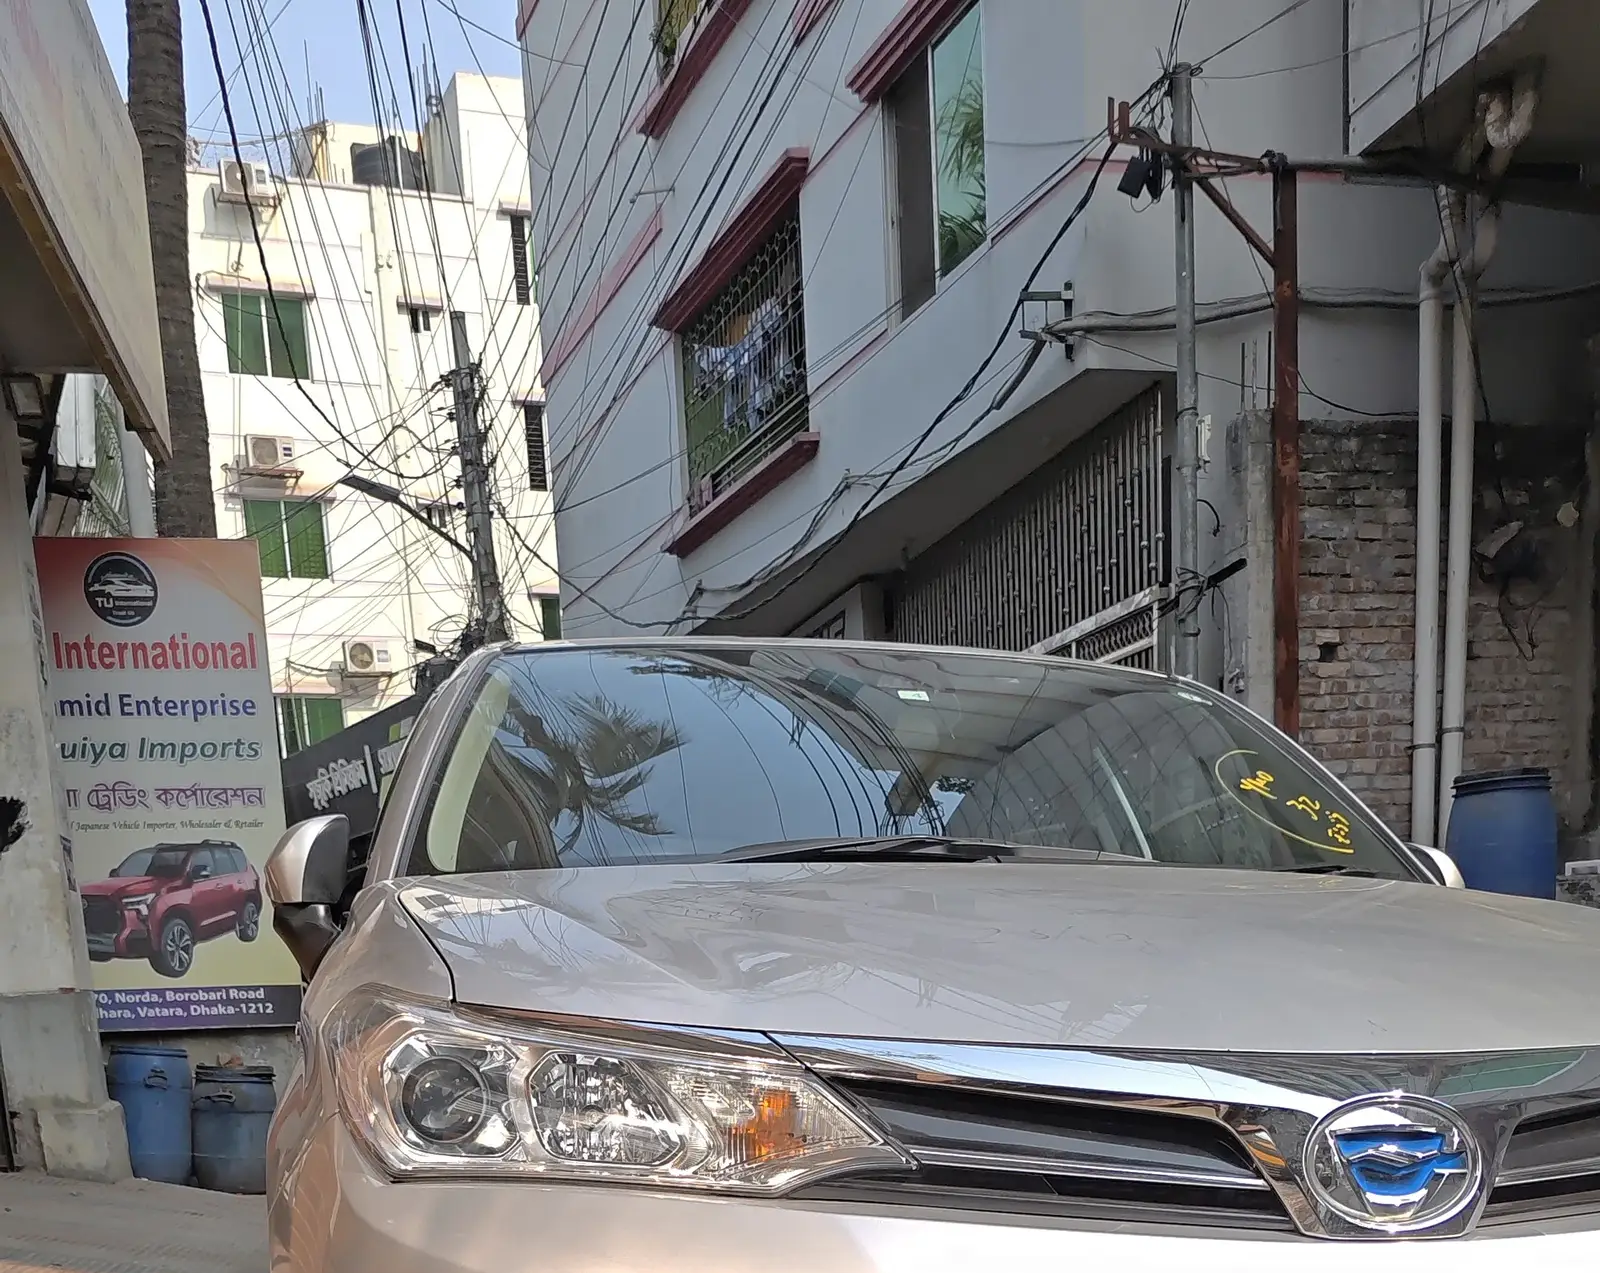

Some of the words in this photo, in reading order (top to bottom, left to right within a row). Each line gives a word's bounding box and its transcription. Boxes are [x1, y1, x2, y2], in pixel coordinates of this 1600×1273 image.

[95, 597, 114, 608] TU
[52, 632, 258, 670] International
[55, 692, 111, 716] mid
[118, 693, 257, 722] Enterprise
[60, 736, 127, 765] uiya
[138, 737, 261, 765] Imports
[87, 781, 150, 811] ট্রেডিং
[154, 782, 264, 808] কর্পোরেশন
[75, 821, 110, 832] Japanese
[113, 820, 141, 830] Vehicle
[143, 820, 178, 832] Importer,
[180, 819, 222, 829] Wholesaler
[224, 819, 232, 829] &
[234, 818, 264, 829] Retailer
[114, 991, 163, 1003] Norda,
[165, 988, 227, 1002] Borobari
[229, 987, 265, 1001] Road
[96, 1006, 135, 1019] hara,
[137, 1005, 187, 1018] Vatara,
[190, 1002, 274, 1017] Dhaka-1212
